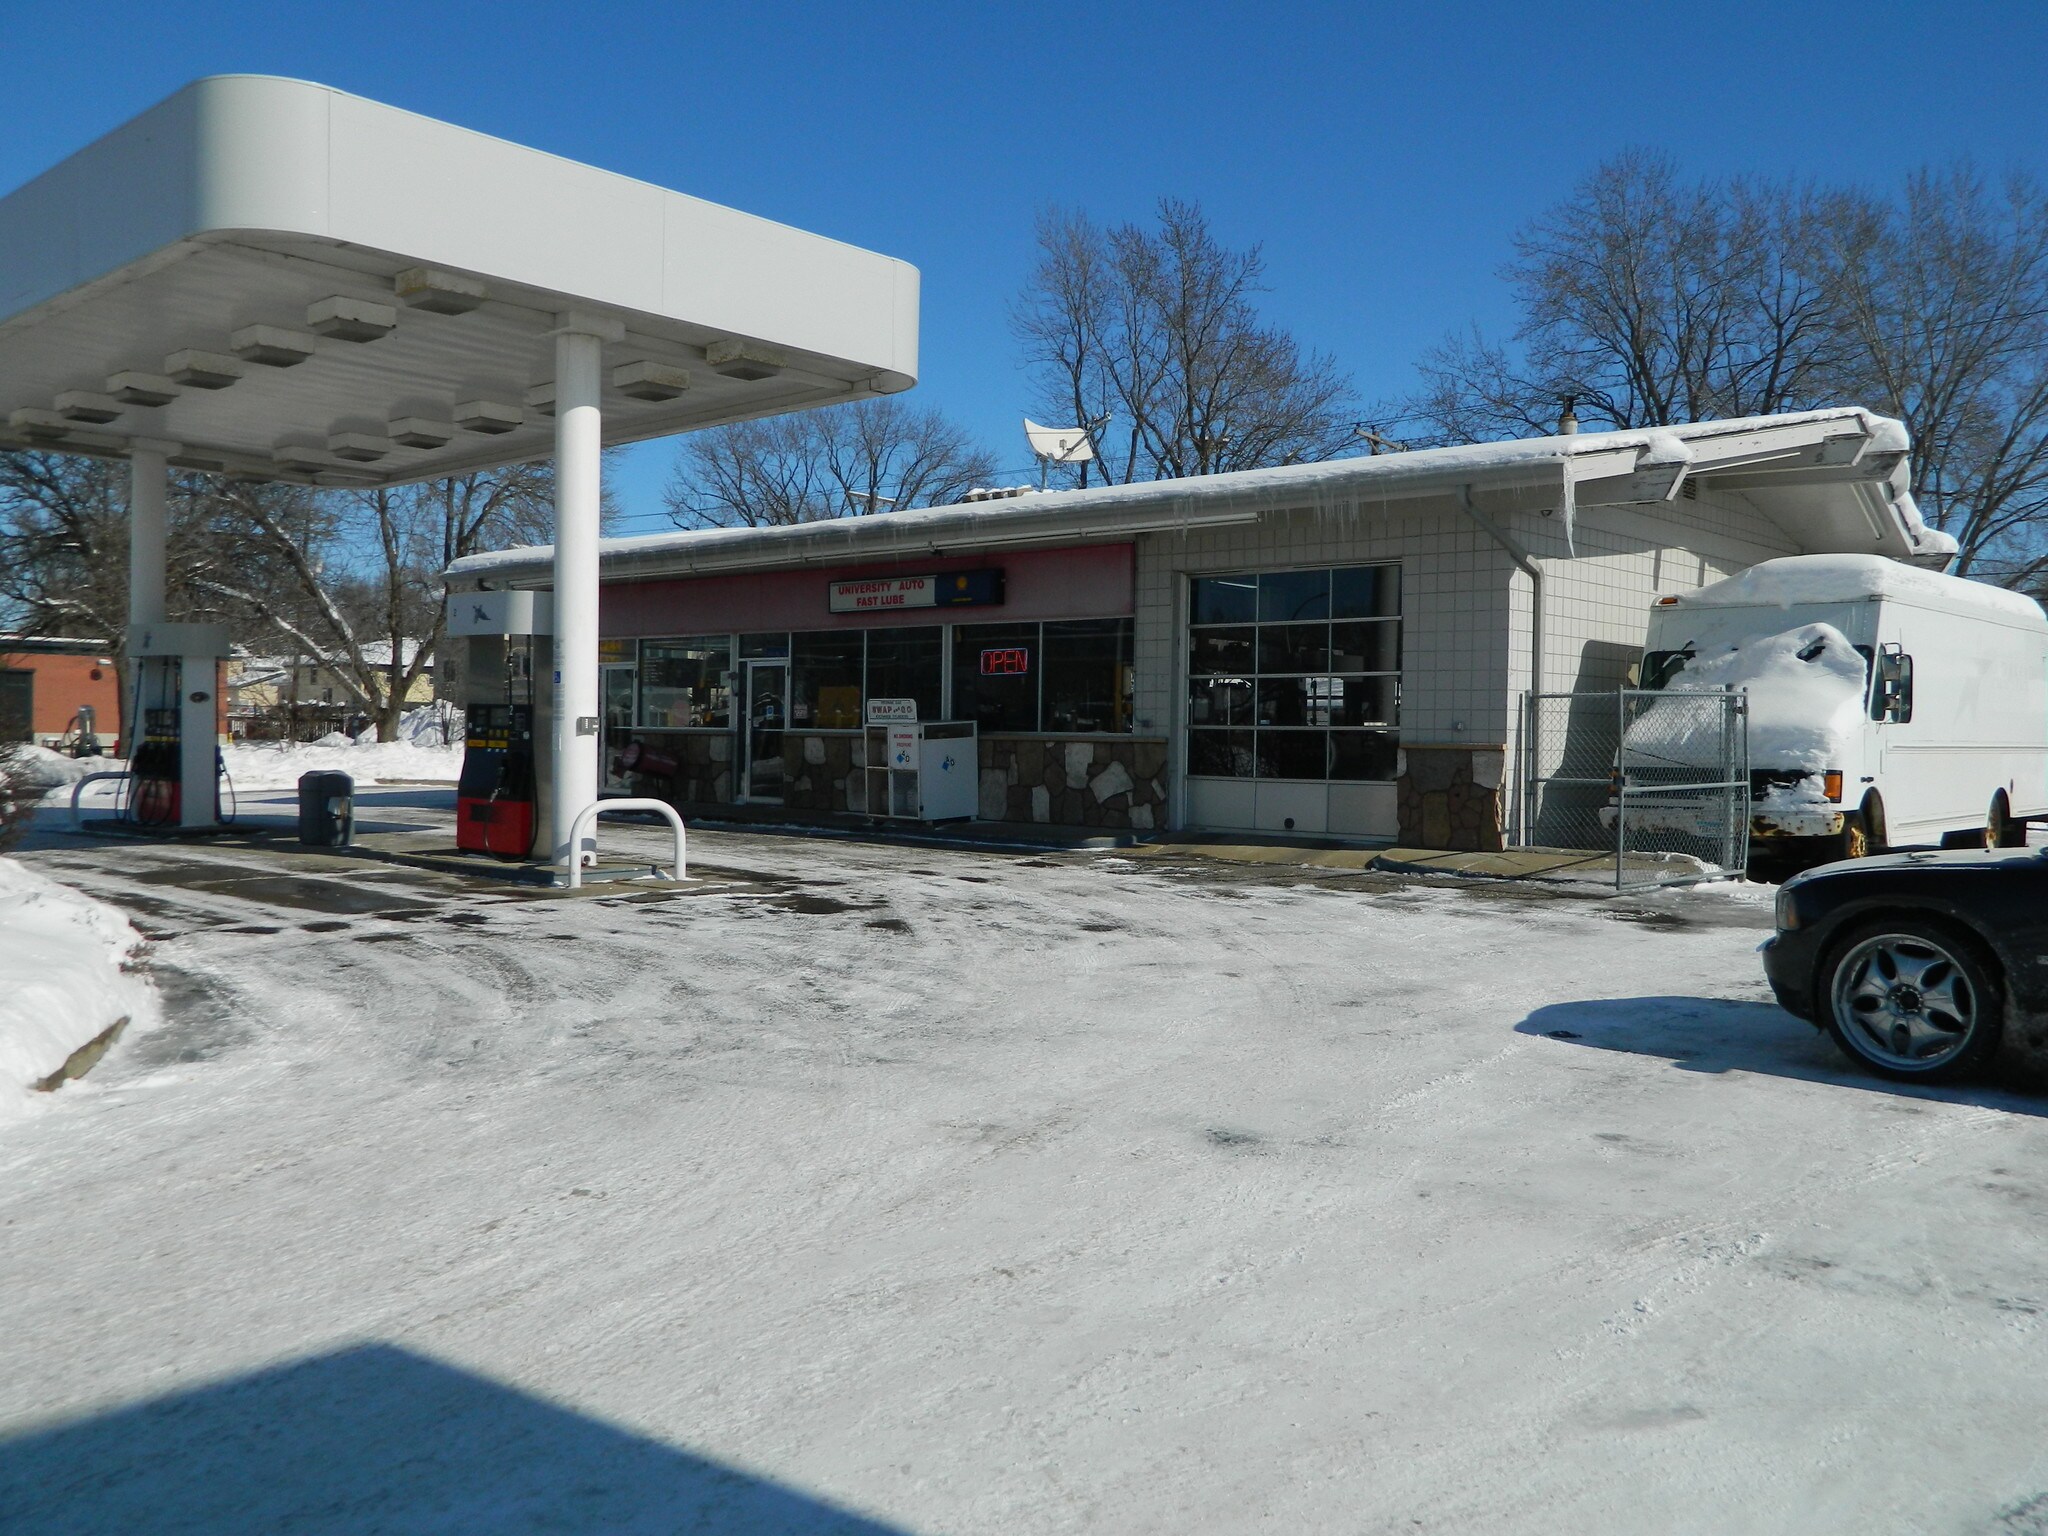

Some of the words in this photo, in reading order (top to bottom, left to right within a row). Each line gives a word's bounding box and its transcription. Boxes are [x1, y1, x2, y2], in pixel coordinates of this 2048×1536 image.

[838, 582, 892, 595] UNIVERSITY
[899, 579, 925, 591] AUTO
[856, 596, 879, 606] FAST
[881, 594, 905, 605] LUBE
[982, 650, 1027, 673] OPEN
[872, 705, 893, 714] SWAP
